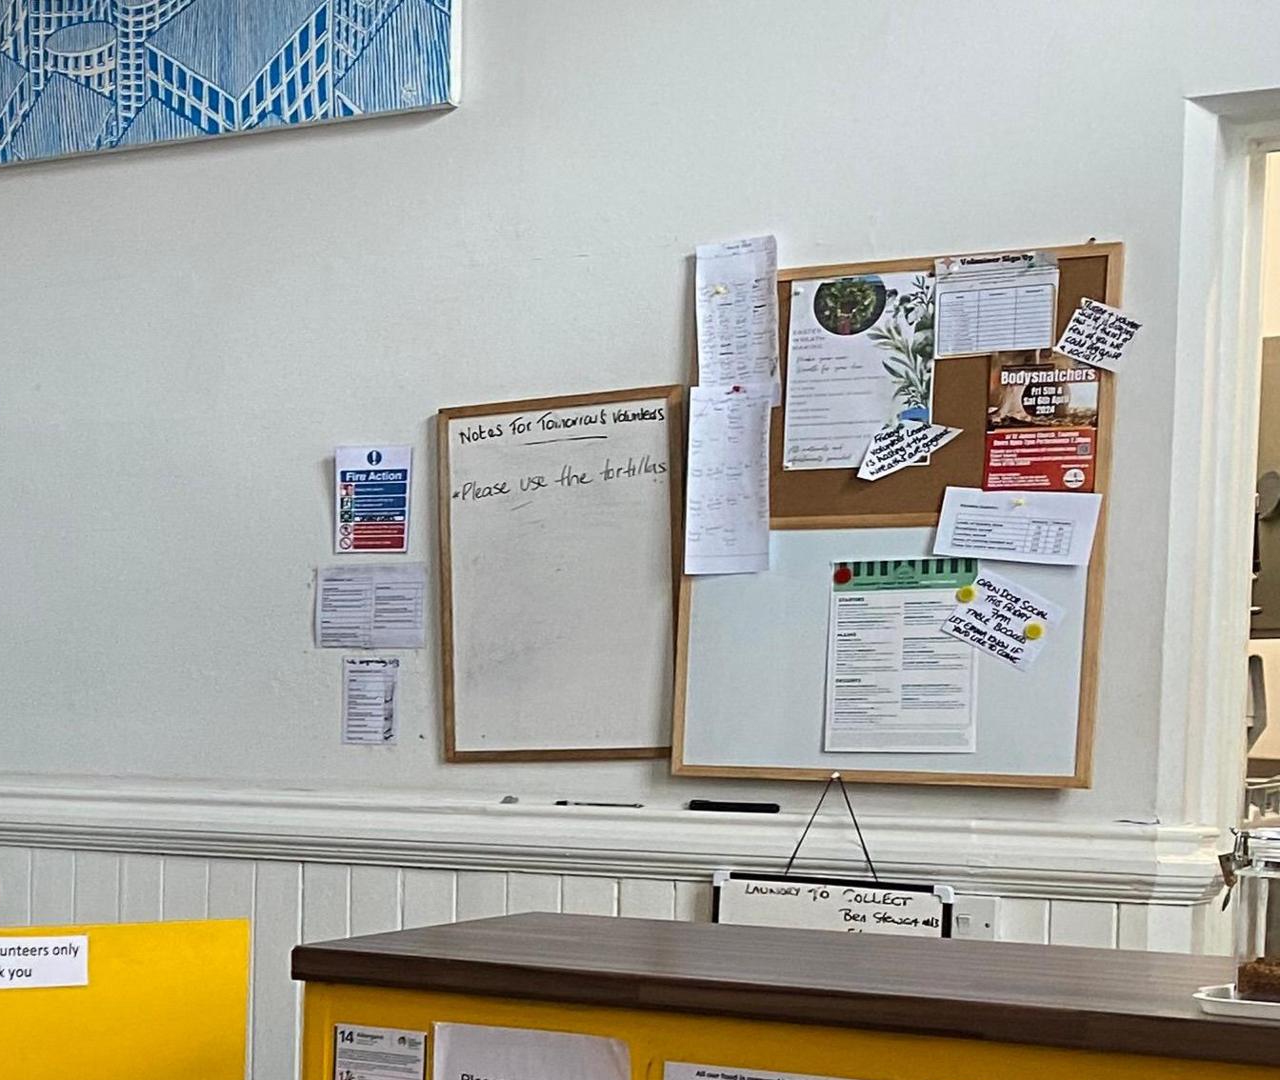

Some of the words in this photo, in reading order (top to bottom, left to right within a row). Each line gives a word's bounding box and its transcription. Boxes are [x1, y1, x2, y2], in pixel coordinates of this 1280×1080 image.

[1001, 369, 1096, 385] Bodysnatchers
[1031, 387, 1042, 395] Fri
[1043, 387, 1056, 395] 5th
[1023, 397, 1036, 406] Sat
[1038, 396, 1051, 404] 6th
[1052, 395, 1069, 405] April
[1036, 406, 1055, 414] 2024
[459, 425, 504, 444] Notes
[510, 417, 532, 435] For
[345, 471, 367, 482] Fire
[369, 470, 403, 481] Action
[520, 476, 548, 492] use
[555, 464, 593, 487] the
[977, 579, 1000, 594] OPEN
[999, 588, 1021, 602] DOOR
[1020, 600, 1048, 620] SOCIAL
[966, 608, 991, 625] TABLE
[985, 595, 1003, 607] THIS
[1003, 602, 1032, 622] FRIDAY
[949, 615, 964, 625] LET
[987, 635, 1009, 649] KNOW
[1010, 646, 1024, 654] IF
[745, 883, 800, 897] LAUNDRY
[808, 889, 830, 902] TO
[842, 888, 914, 907] COLLECT
[52, 943, 79, 957] only
[8, 968, 32, 980] you
[339, 1030, 353, 1043] 14
